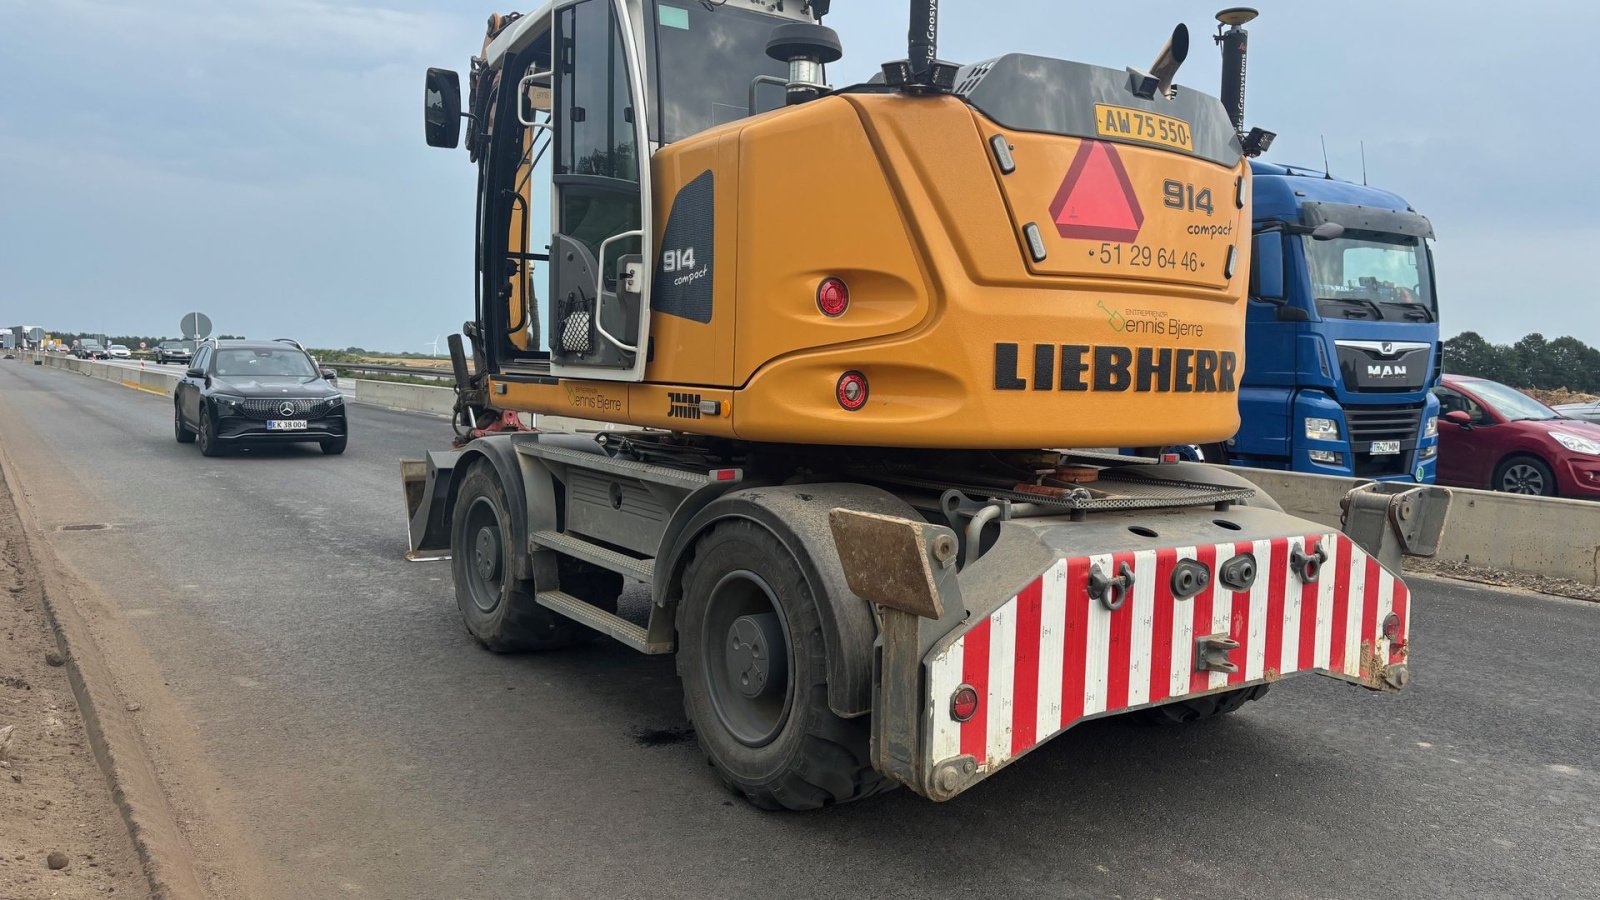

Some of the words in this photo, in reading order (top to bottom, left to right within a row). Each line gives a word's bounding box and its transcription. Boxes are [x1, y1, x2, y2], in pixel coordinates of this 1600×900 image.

[1105, 109, 1131, 134] AW
[1133, 113, 1156, 138] 75
[1158, 118, 1187, 146] 550
[1163, 178, 1214, 217] 914
[1187, 220, 1232, 240] compact
[663, 246, 696, 273] 914
[1100, 242, 1121, 265] 51
[1130, 245, 1152, 267] 29
[1157, 247, 1177, 270] 64
[1181, 250, 1198, 272] 46
[674, 263, 708, 286] compact
[1168, 318, 1204, 340] Bjerre
[993, 342, 1237, 393] LIEBHERR
[1367, 365, 1407, 378] MAN
[597, 394, 622, 413] Bjerre
